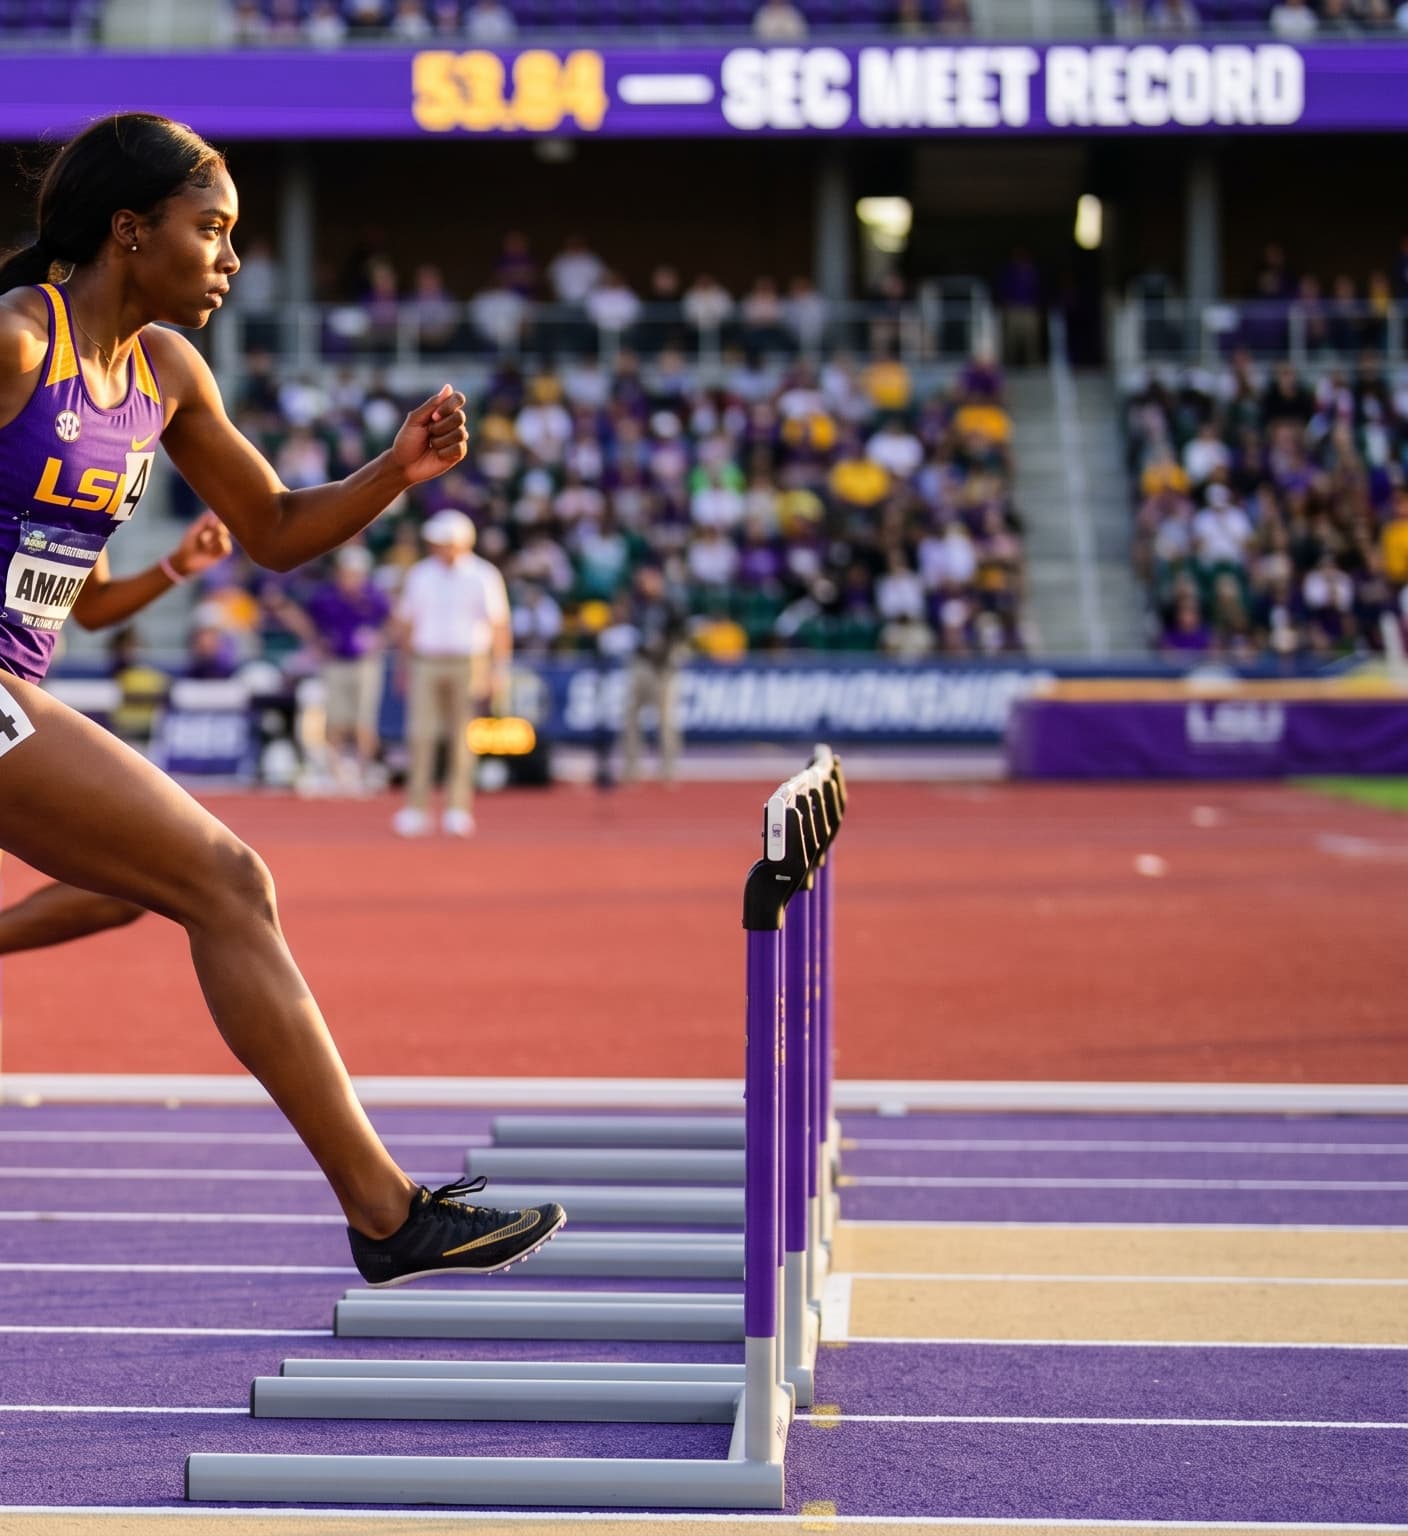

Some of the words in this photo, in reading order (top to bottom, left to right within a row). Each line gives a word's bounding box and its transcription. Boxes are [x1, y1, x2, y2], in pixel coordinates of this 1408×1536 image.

[721, 47, 852, 130] SEC
[858, 46, 1040, 128] MEET
[1046, 45, 1305, 126] RECORD
[57, 412, 80, 440] SEC
[124, 459, 148, 516] 4
[1187, 702, 1285, 743] LSU
